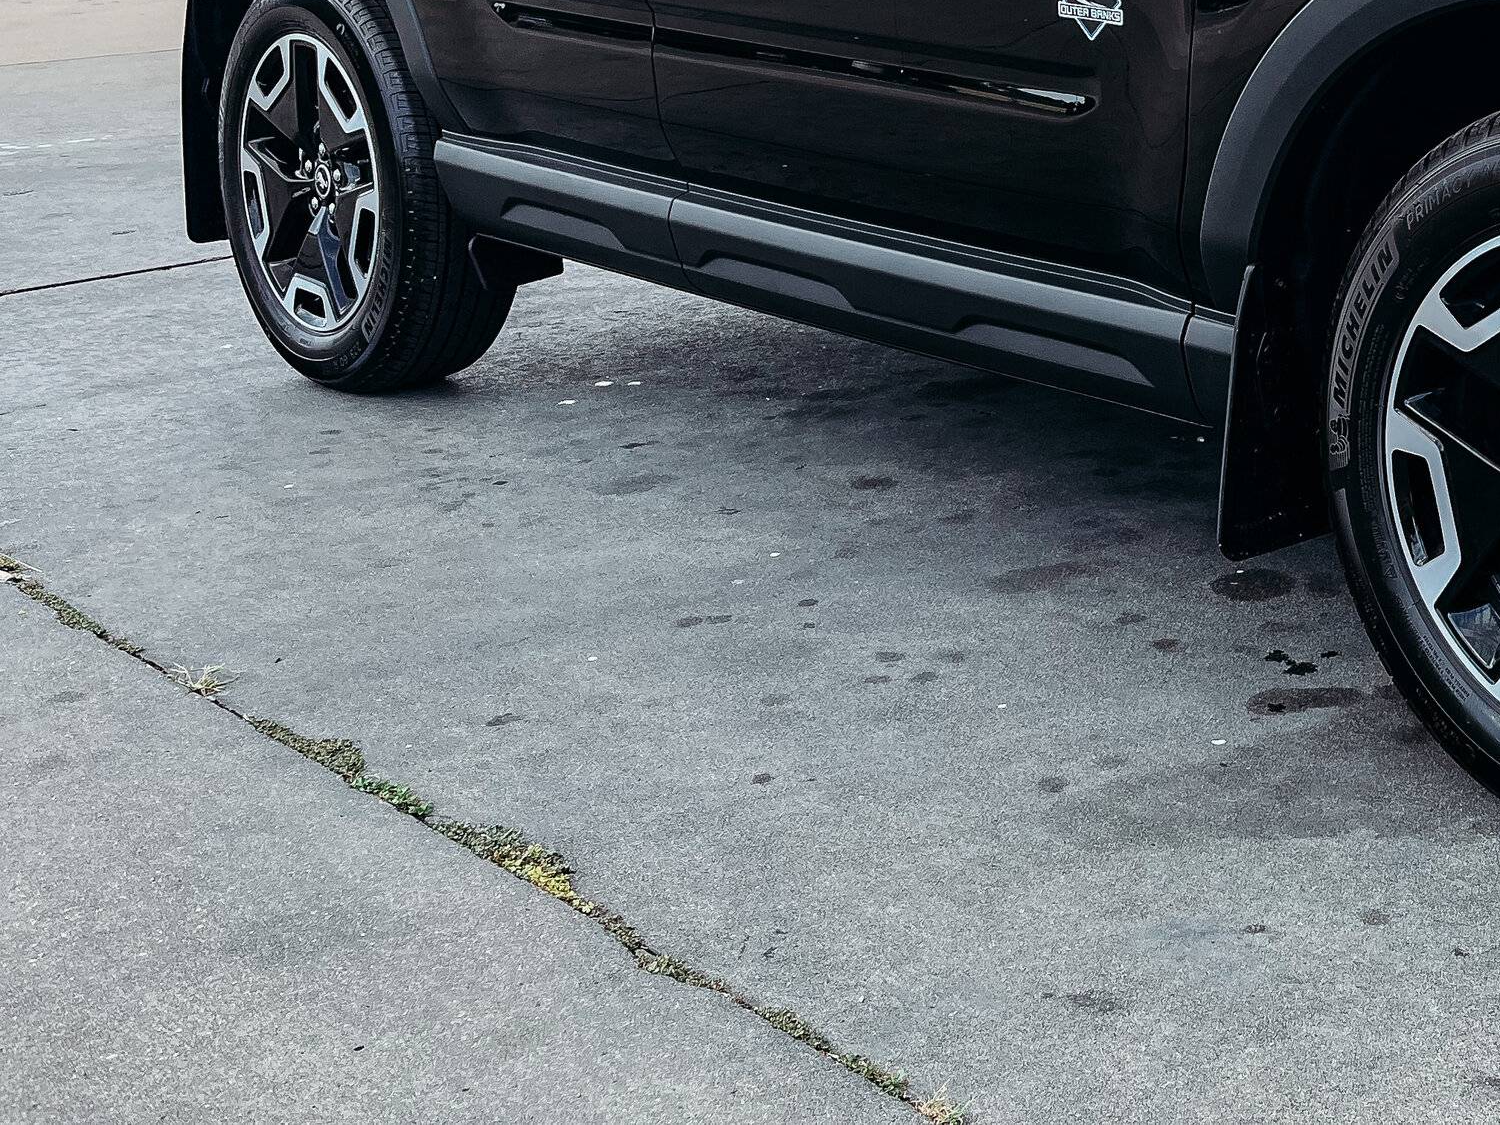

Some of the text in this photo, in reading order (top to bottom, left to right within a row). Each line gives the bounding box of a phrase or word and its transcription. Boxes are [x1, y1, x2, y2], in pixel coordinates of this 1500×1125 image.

[1060, 4, 1121, 22] OUTER BANKS
[1331, 241, 1396, 405] MICHELIN
